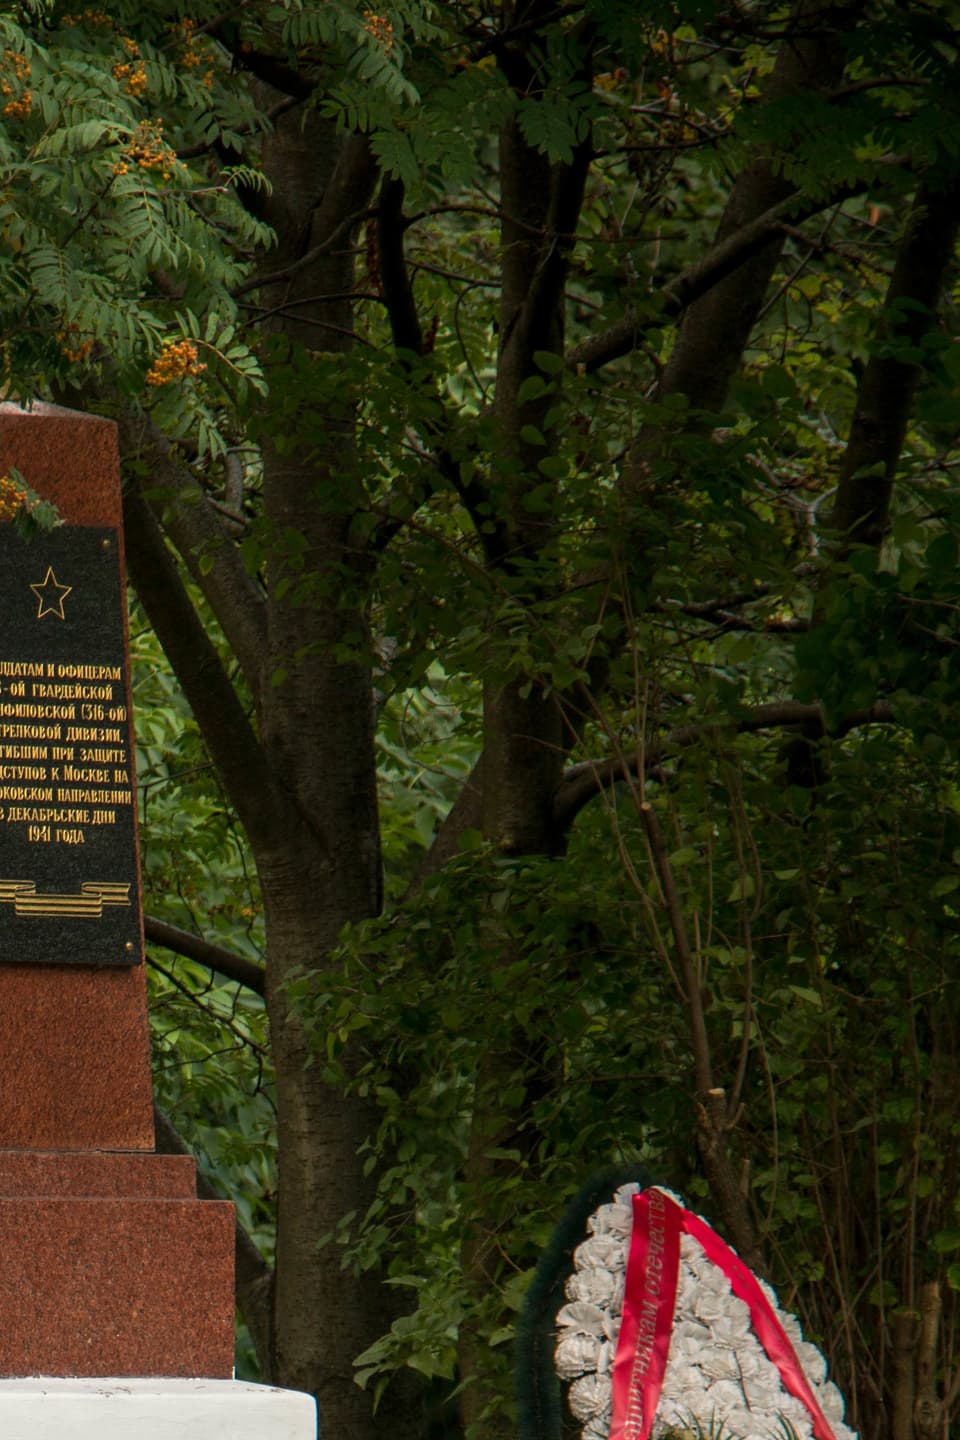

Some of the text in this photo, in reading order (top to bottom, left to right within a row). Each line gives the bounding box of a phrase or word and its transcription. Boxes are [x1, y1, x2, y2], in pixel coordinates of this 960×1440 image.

[47, 663, 55, 677] И
[58, 663, 121, 681] ОФИЦЕРАМ
[32, 682, 113, 701] ГВАРДЕЙСКОЙ
[81, 704, 128, 723] (316-ОЙ)
[52, 747, 74, 762] ПРИ
[79, 749, 127, 764] ЗАЩИТЕ
[51, 768, 60, 781] К
[63, 765, 110, 784] МОСКВЕ
[114, 770, 128, 784] НА
[58, 789, 131, 805] НАПРАВЛЕНИИ
[7, 807, 90, 824] ДЕКАБРЬСКИЕ
[92, 810, 116, 825] ДНИ
[28, 826, 85, 844] 1941 ГОДА
[644, 1189, 666, 1296] отечества
